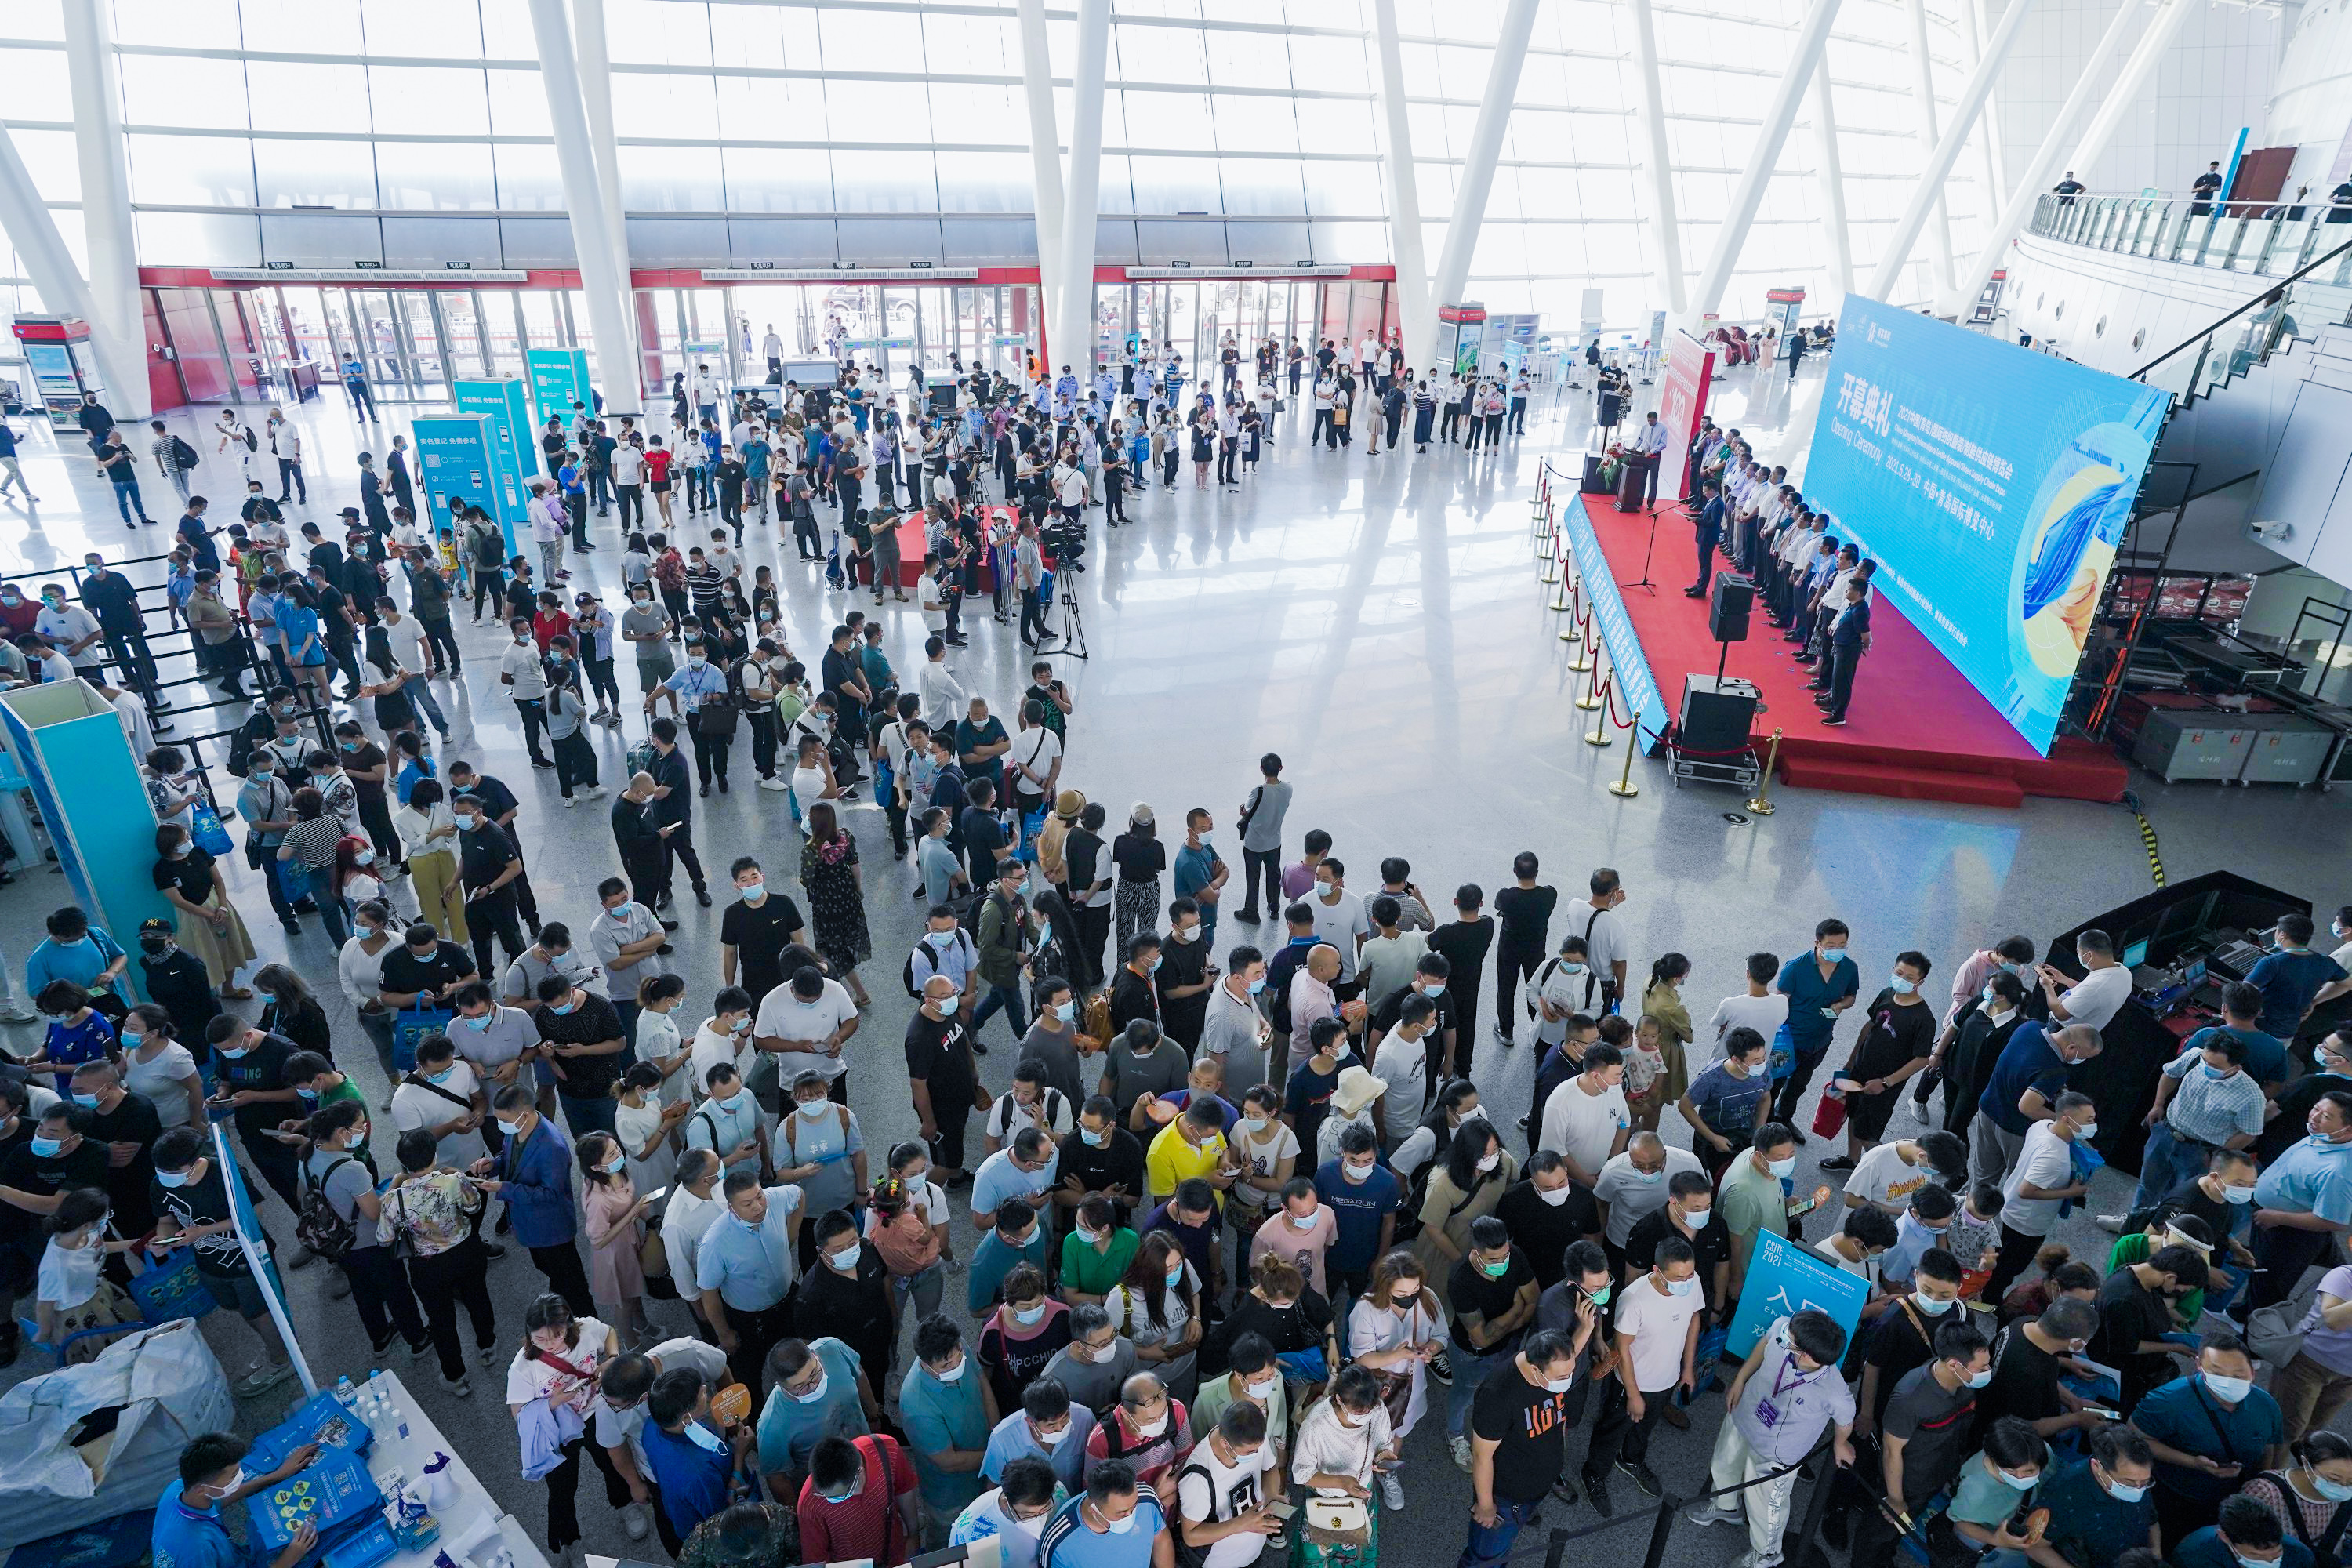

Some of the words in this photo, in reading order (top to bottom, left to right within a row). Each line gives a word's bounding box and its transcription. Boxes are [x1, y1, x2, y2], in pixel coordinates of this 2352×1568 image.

[1836, 372, 1893, 437] 开幕典礼
[1831, 416, 1853, 446] Opening
[1853, 430, 1883, 466] Ceremony
[1885, 454, 1921, 488] 2021.6.28-30
[940, 1022, 963, 1052] FILA
[1762, 1249, 1782, 1268] 2021
[1765, 1240, 1785, 1257] CSITE
